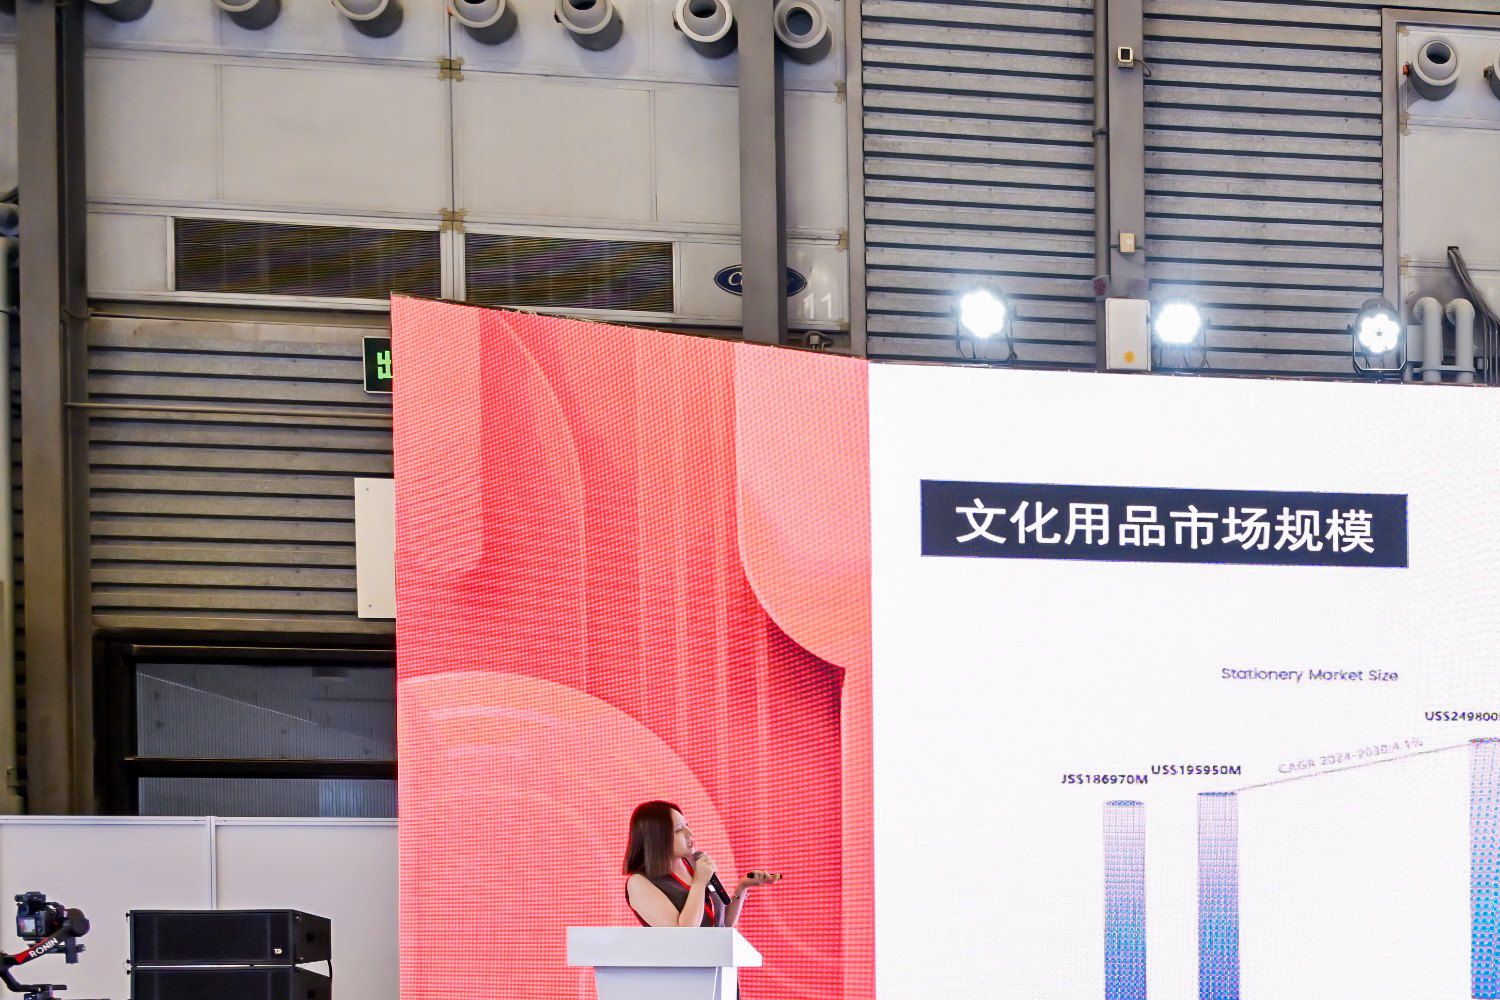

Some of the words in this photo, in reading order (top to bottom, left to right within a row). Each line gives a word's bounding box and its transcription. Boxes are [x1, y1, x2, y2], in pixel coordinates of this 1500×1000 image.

[803, 291, 832, 319] 11
[955, 498, 1376, 554] 文化用品市场规模
[1221, 667, 1303, 682] Stationery
[1309, 669, 1363, 681] Market
[1368, 669, 1399, 682] Size
[28, 937, 59, 958] RONIN
